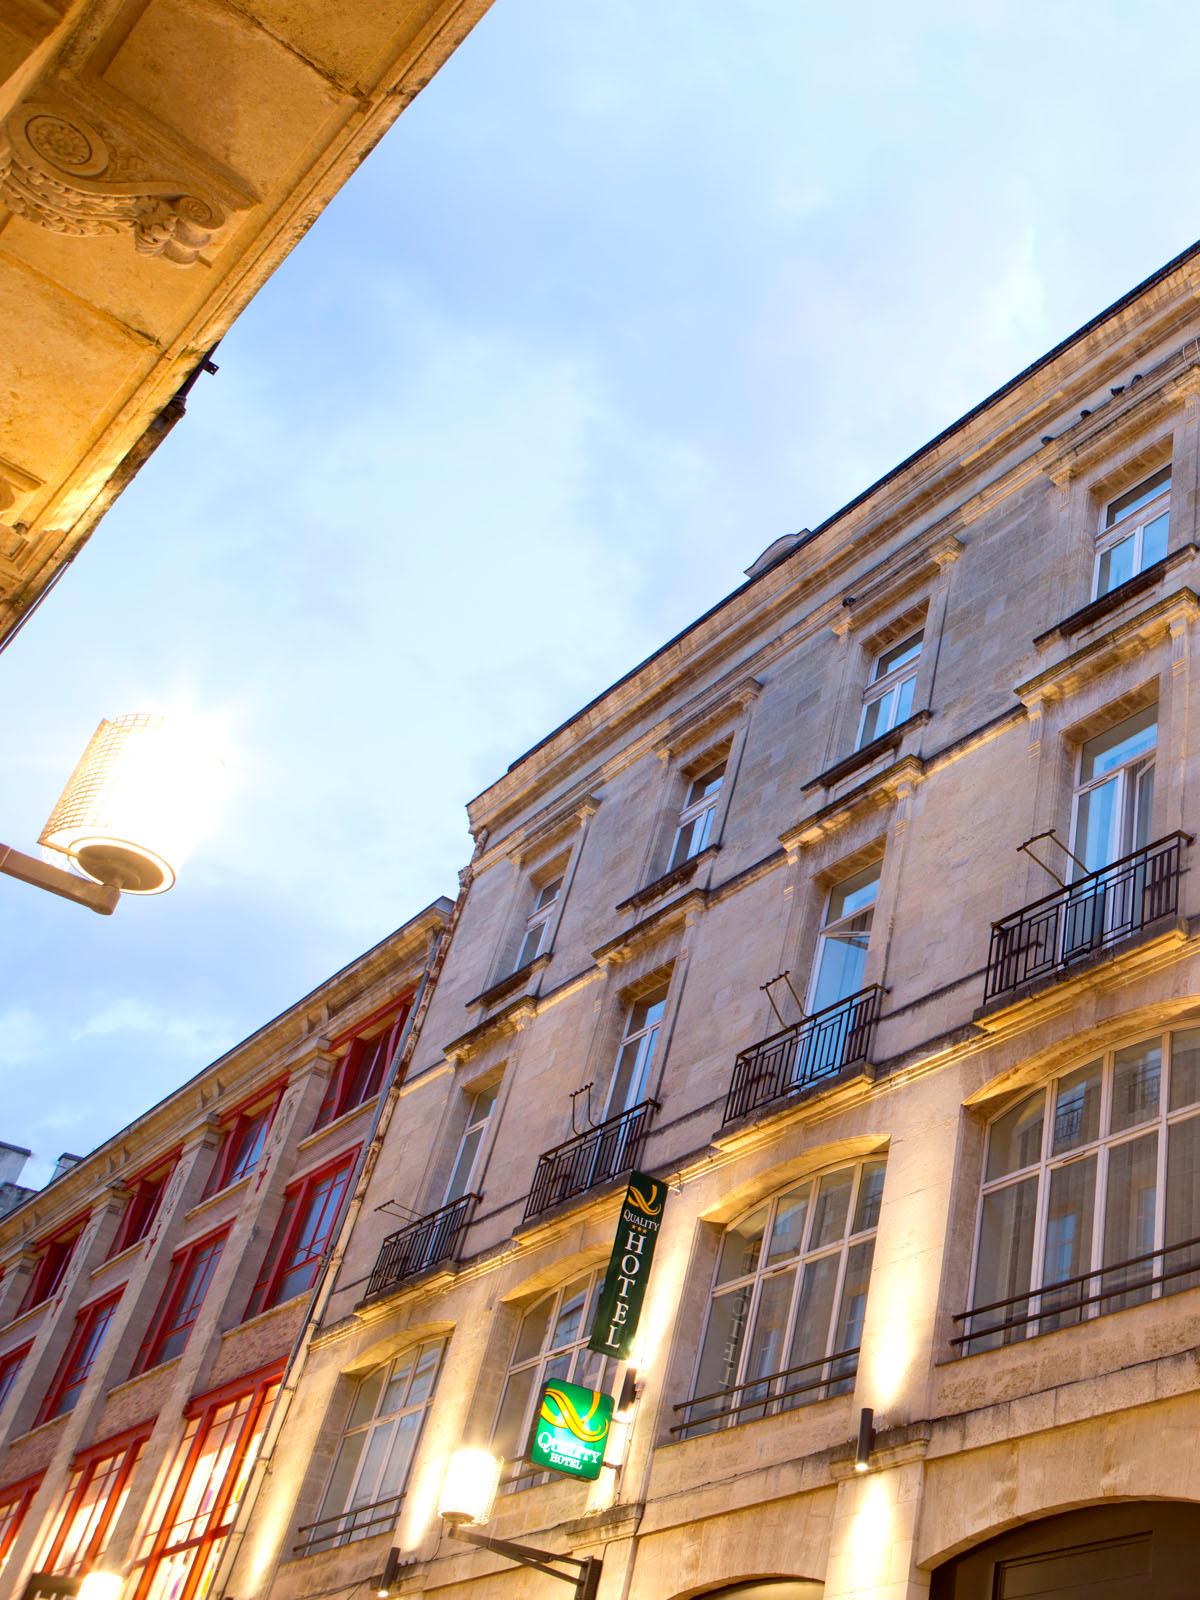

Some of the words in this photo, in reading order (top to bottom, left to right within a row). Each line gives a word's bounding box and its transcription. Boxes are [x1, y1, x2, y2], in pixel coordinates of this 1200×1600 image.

[624, 1209, 660, 1232] QUALITY
[605, 1230, 647, 1348] HOTEL
[538, 1431, 602, 1464] QUTY
[549, 1453, 583, 1470] HOTEL
